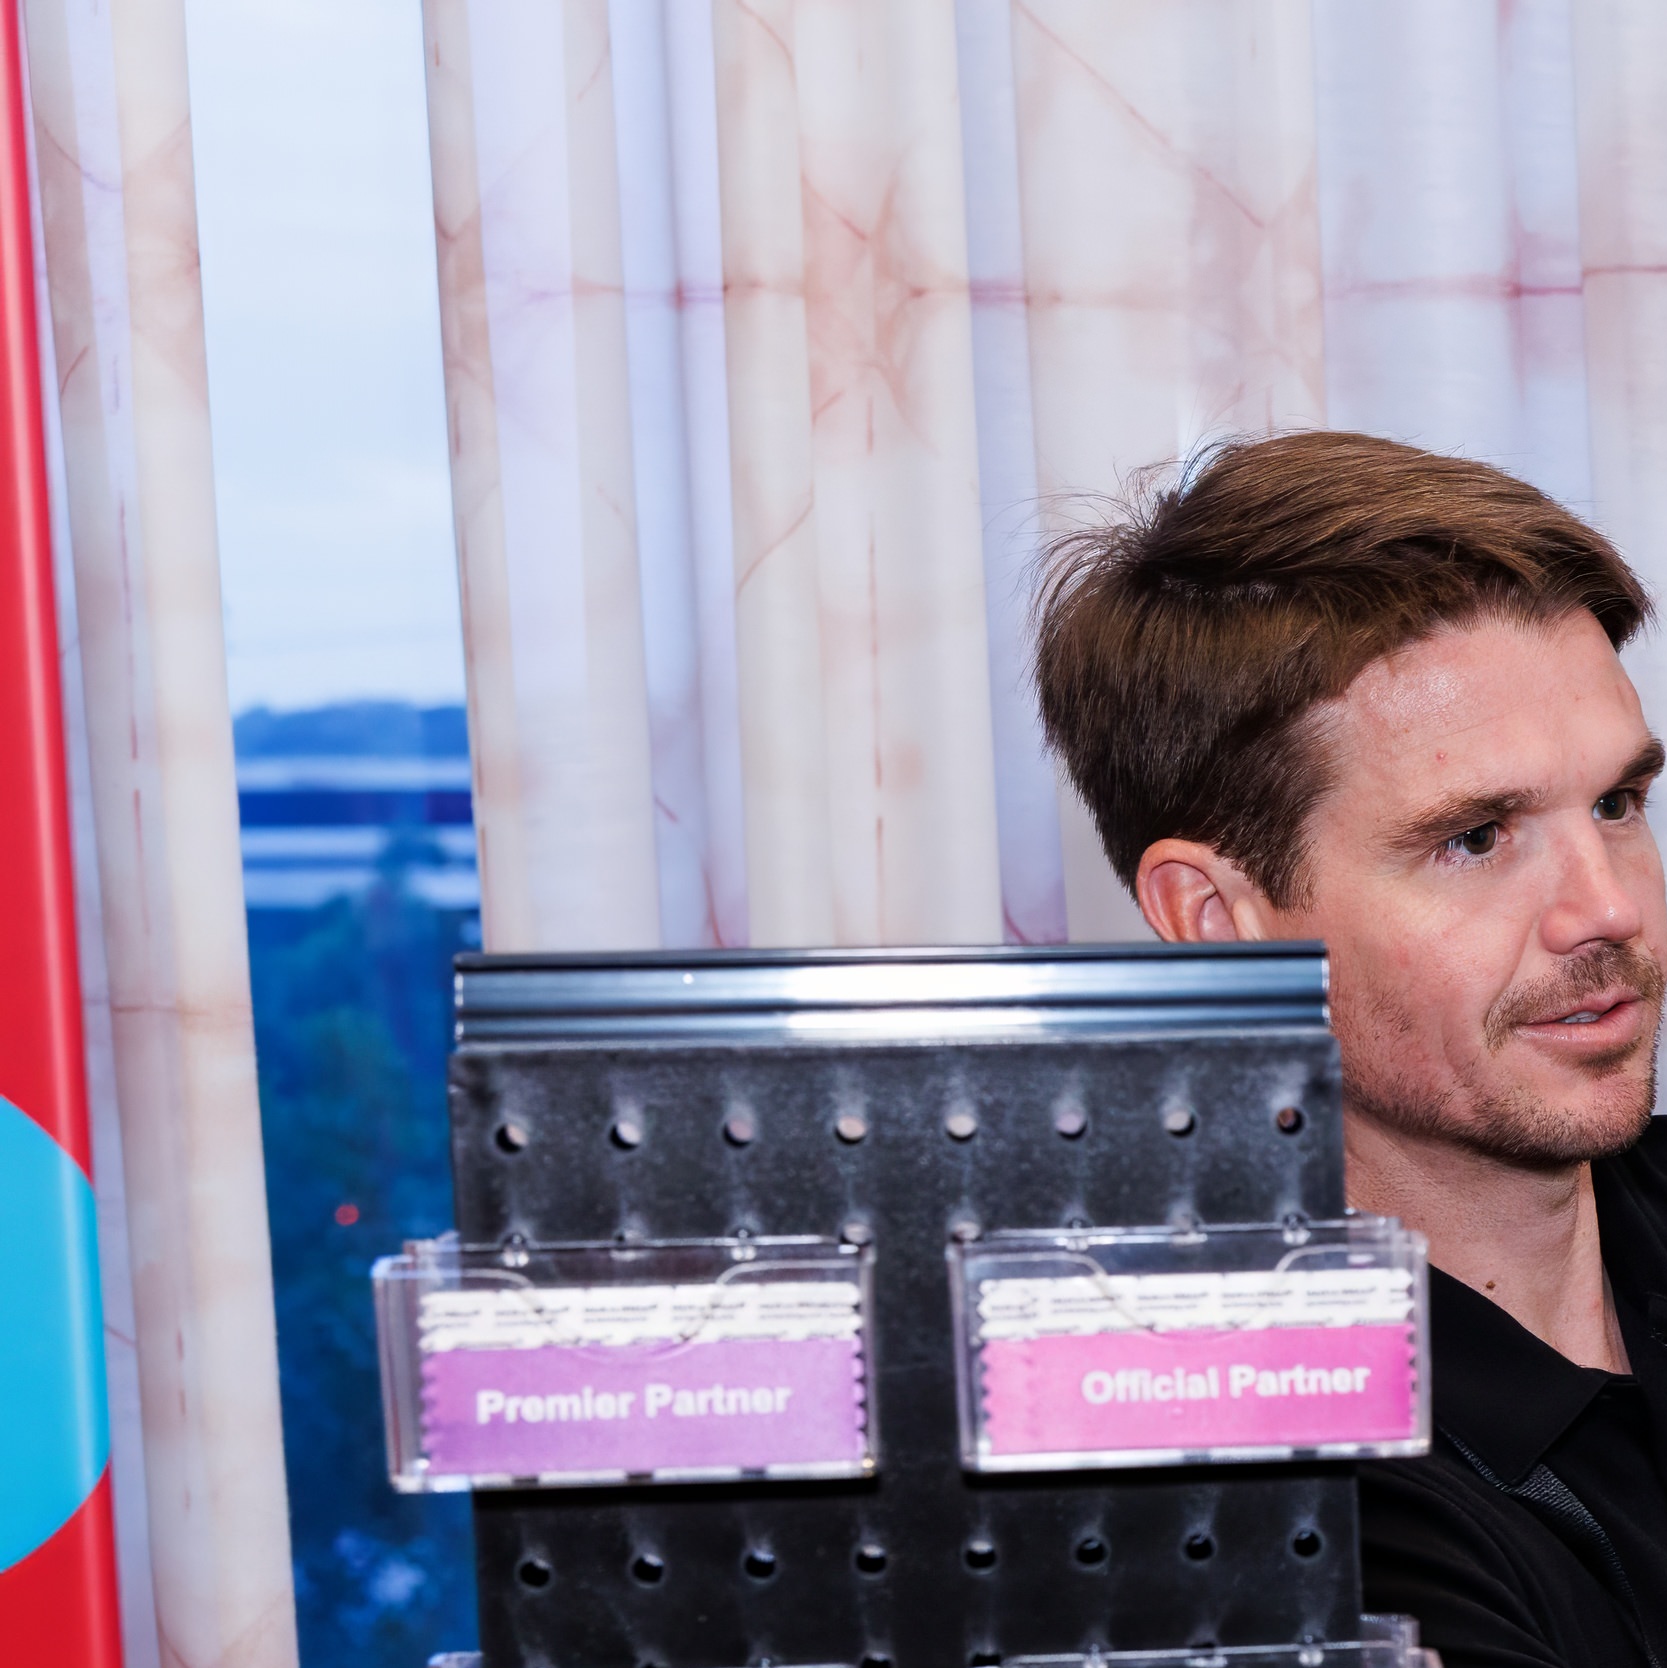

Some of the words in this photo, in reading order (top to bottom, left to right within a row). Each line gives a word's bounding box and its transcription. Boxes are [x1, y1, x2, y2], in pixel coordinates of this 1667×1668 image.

[475, 1385, 635, 1424] Premier
[644, 1383, 792, 1419] Partner
[1081, 1366, 1219, 1405] Official
[1229, 1364, 1371, 1399] Partner
